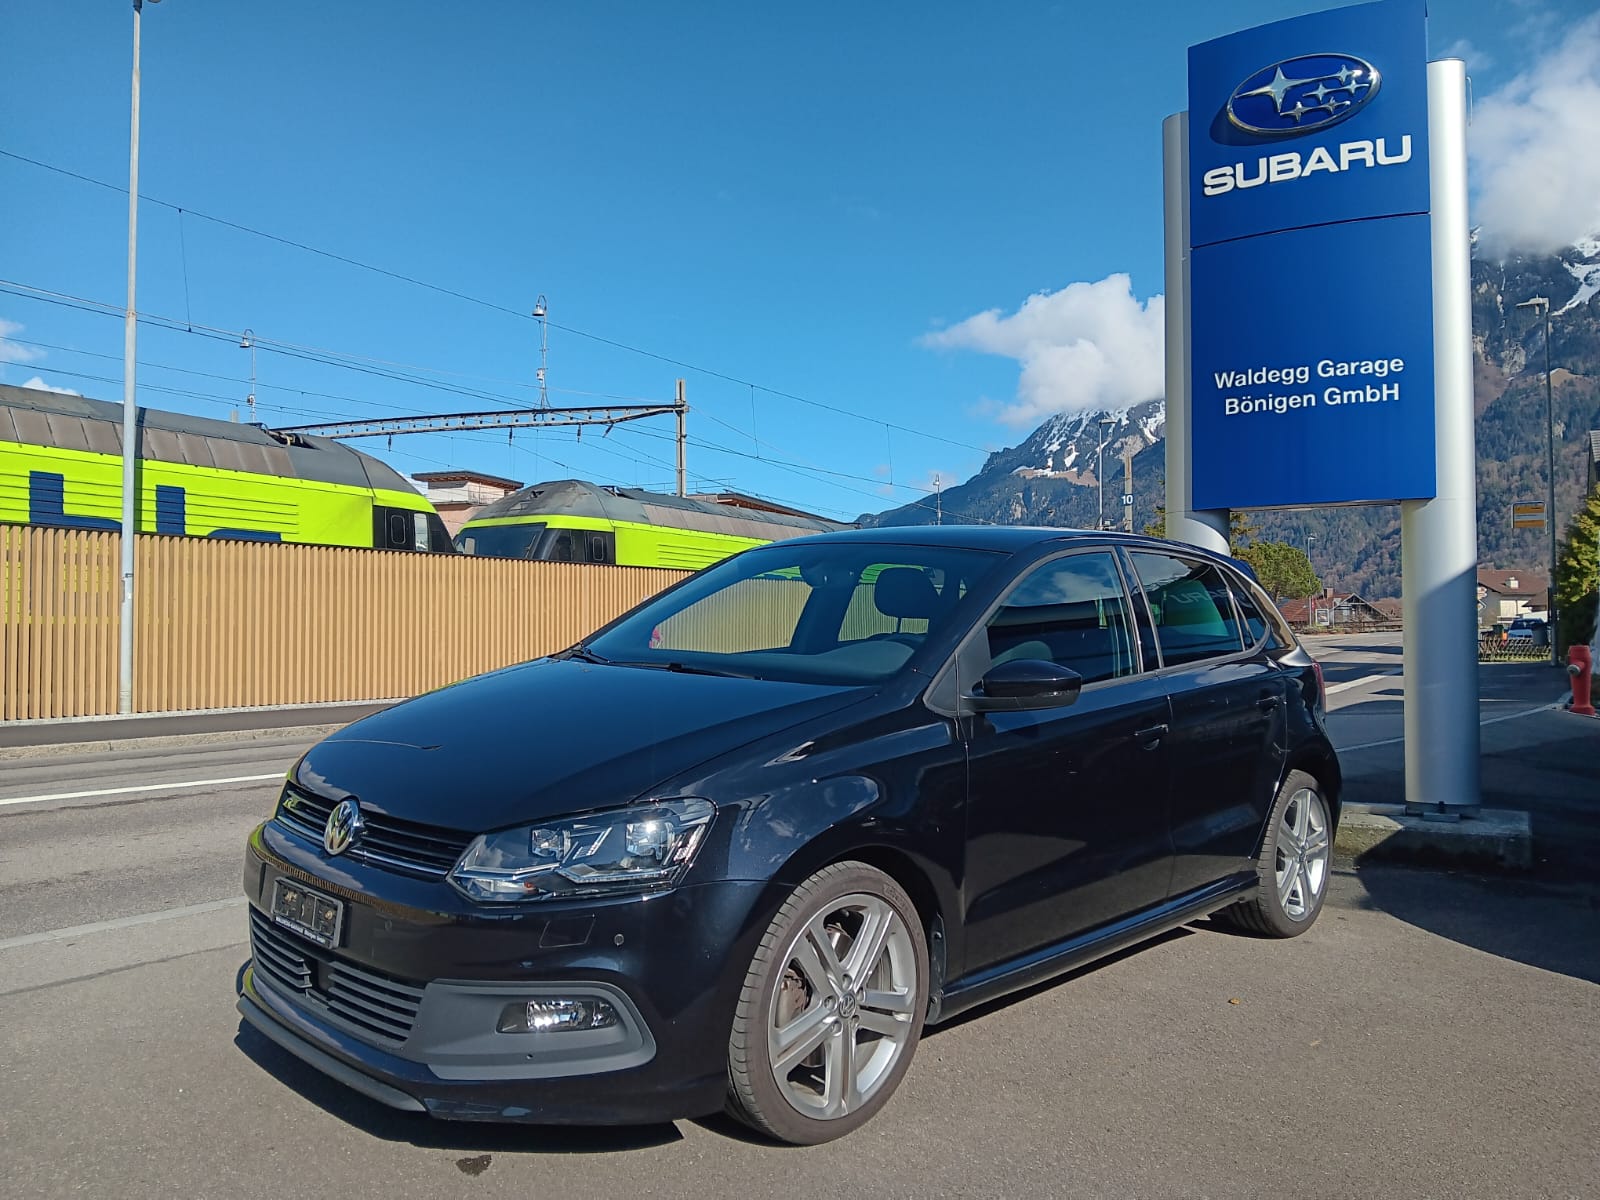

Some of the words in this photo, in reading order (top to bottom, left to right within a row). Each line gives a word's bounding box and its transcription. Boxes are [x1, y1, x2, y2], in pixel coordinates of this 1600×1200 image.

[1204, 135, 1412, 196] SUBARU
[1214, 366, 1310, 389] Waldegg
[1317, 358, 1405, 377] Garage
[1225, 393, 1316, 415] Bönigen
[1323, 383, 1400, 405] GmbH
[1120, 494, 1133, 505] 10
